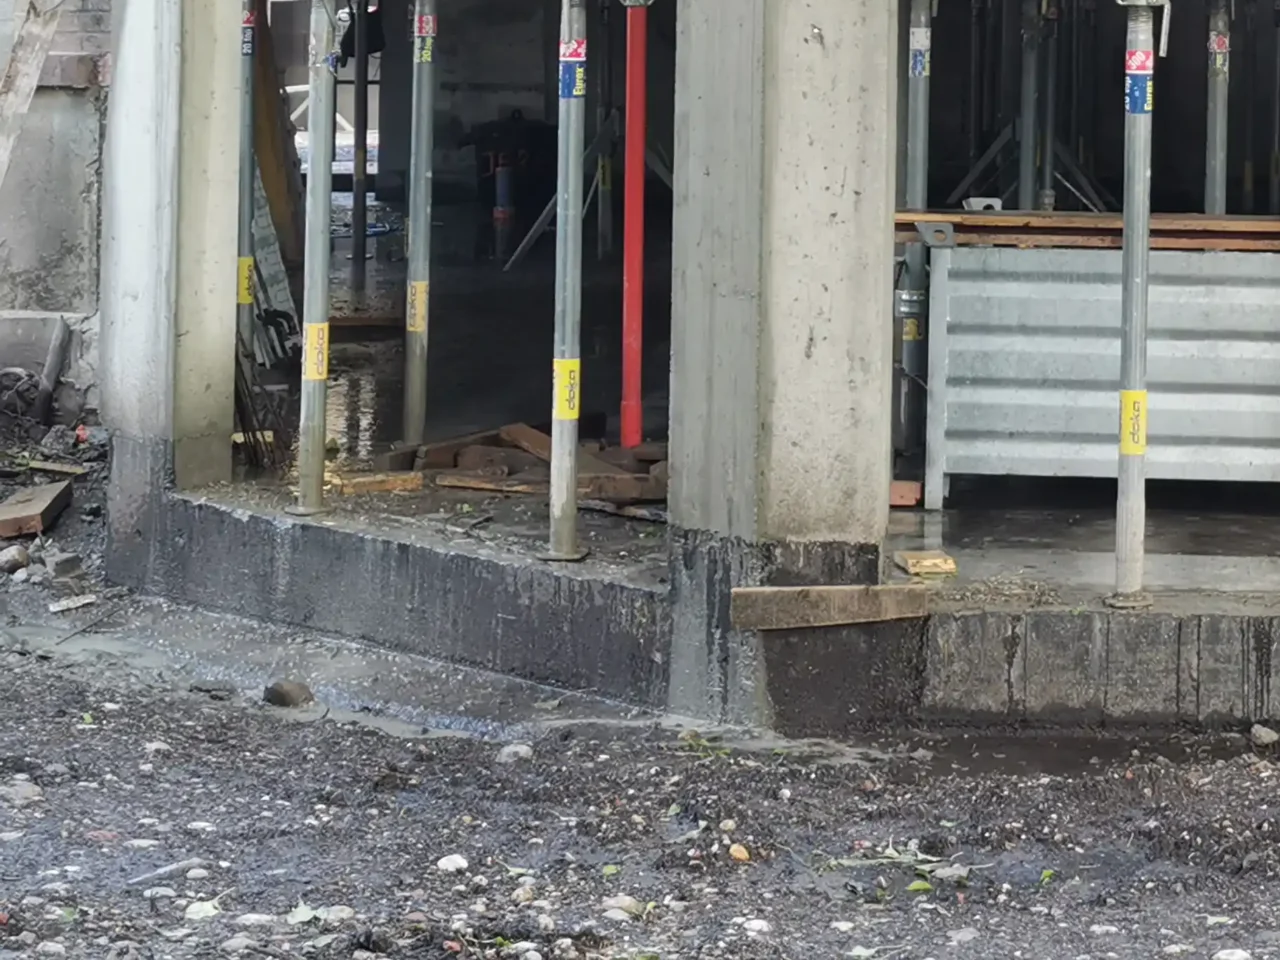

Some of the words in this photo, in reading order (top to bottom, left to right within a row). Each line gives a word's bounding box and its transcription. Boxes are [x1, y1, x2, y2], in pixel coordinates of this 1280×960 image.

[314, 327, 326, 376] doka
[564, 369, 576, 411] doka
[1129, 400, 1141, 445] doka
